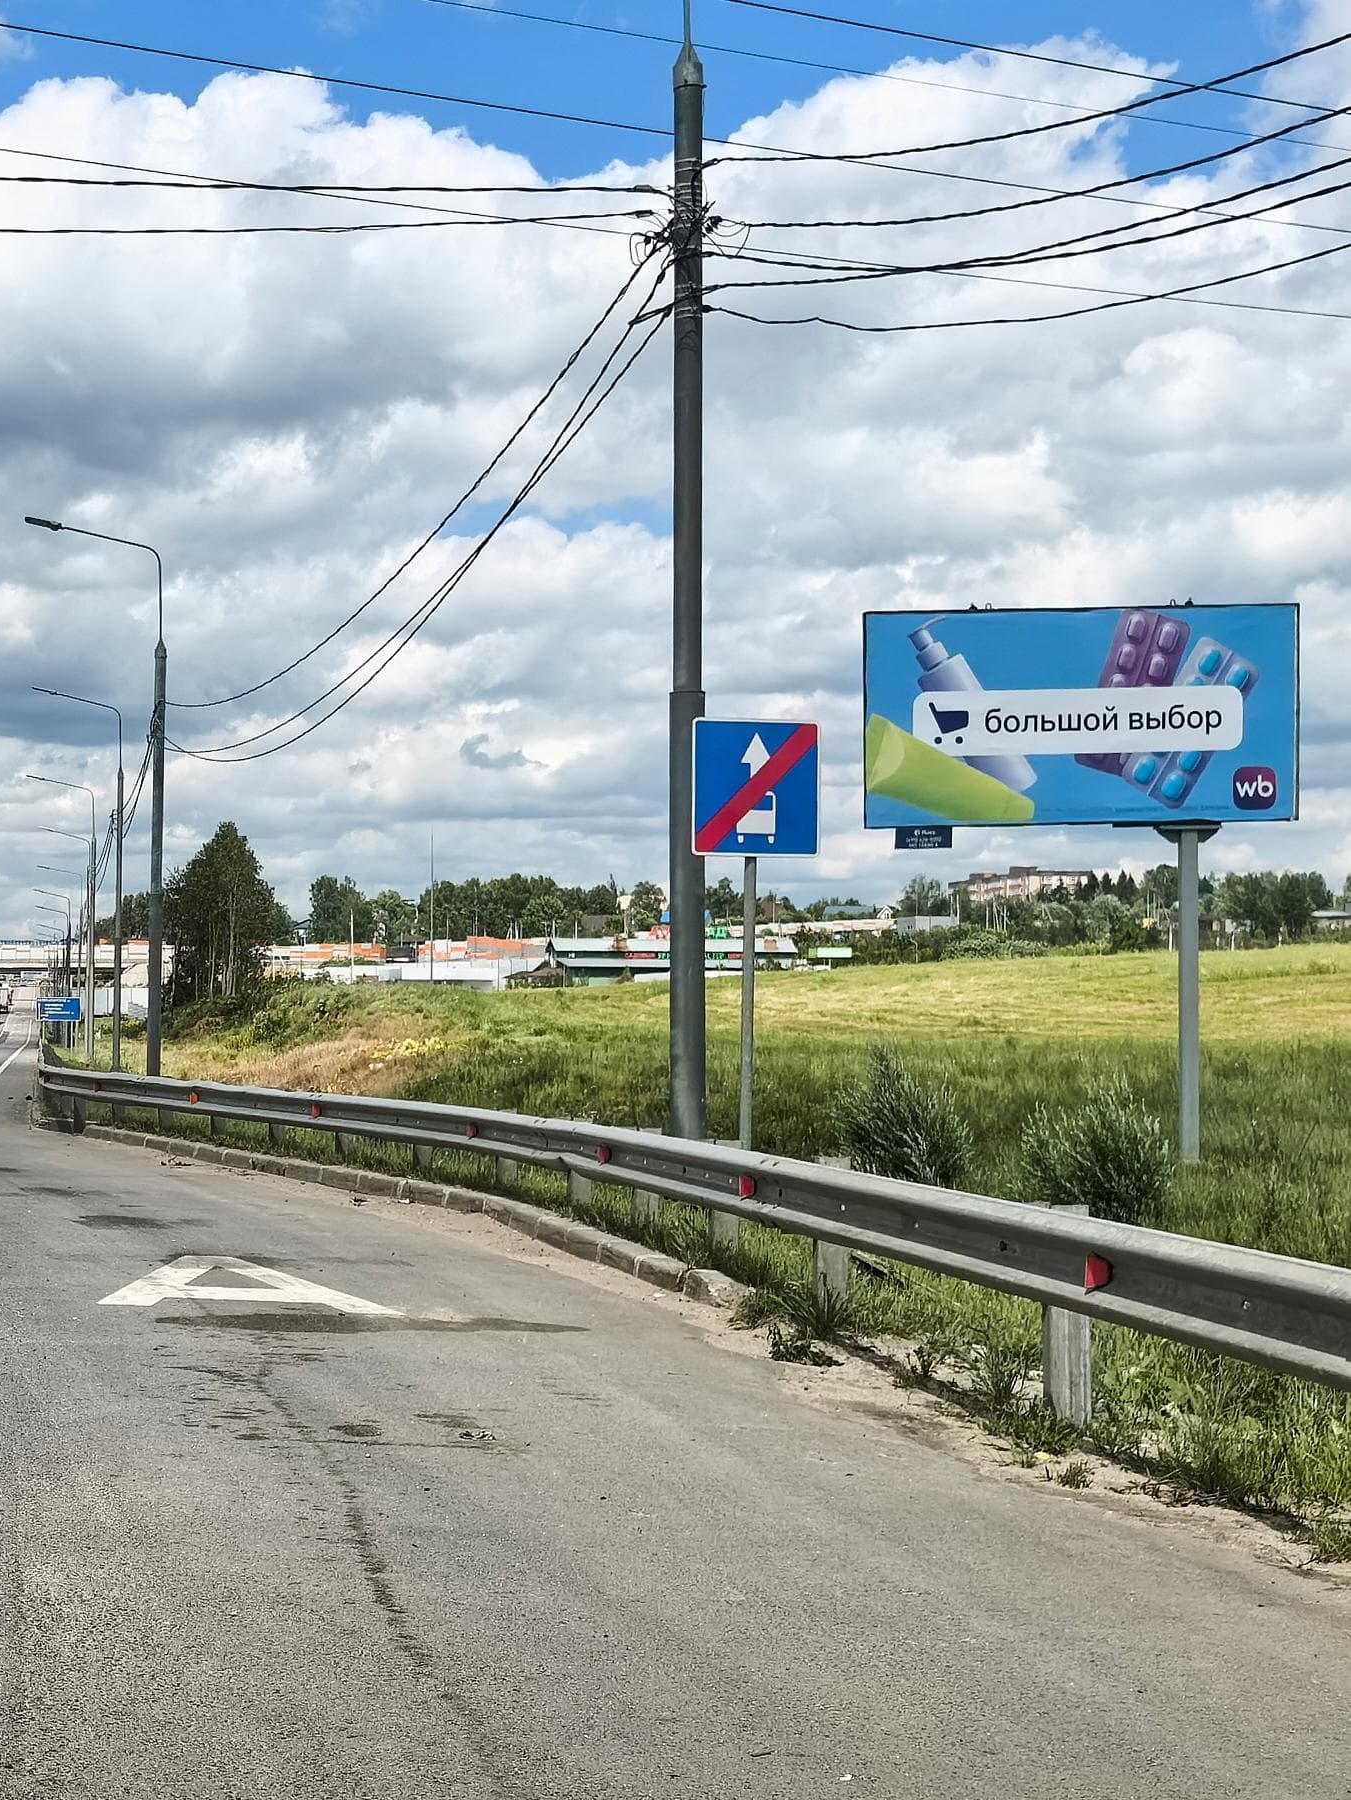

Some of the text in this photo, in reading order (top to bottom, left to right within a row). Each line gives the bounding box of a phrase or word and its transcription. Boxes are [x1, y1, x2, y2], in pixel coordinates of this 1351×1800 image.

[984, 704, 1223, 736] большой выбор
[1235, 774, 1274, 798] wb
